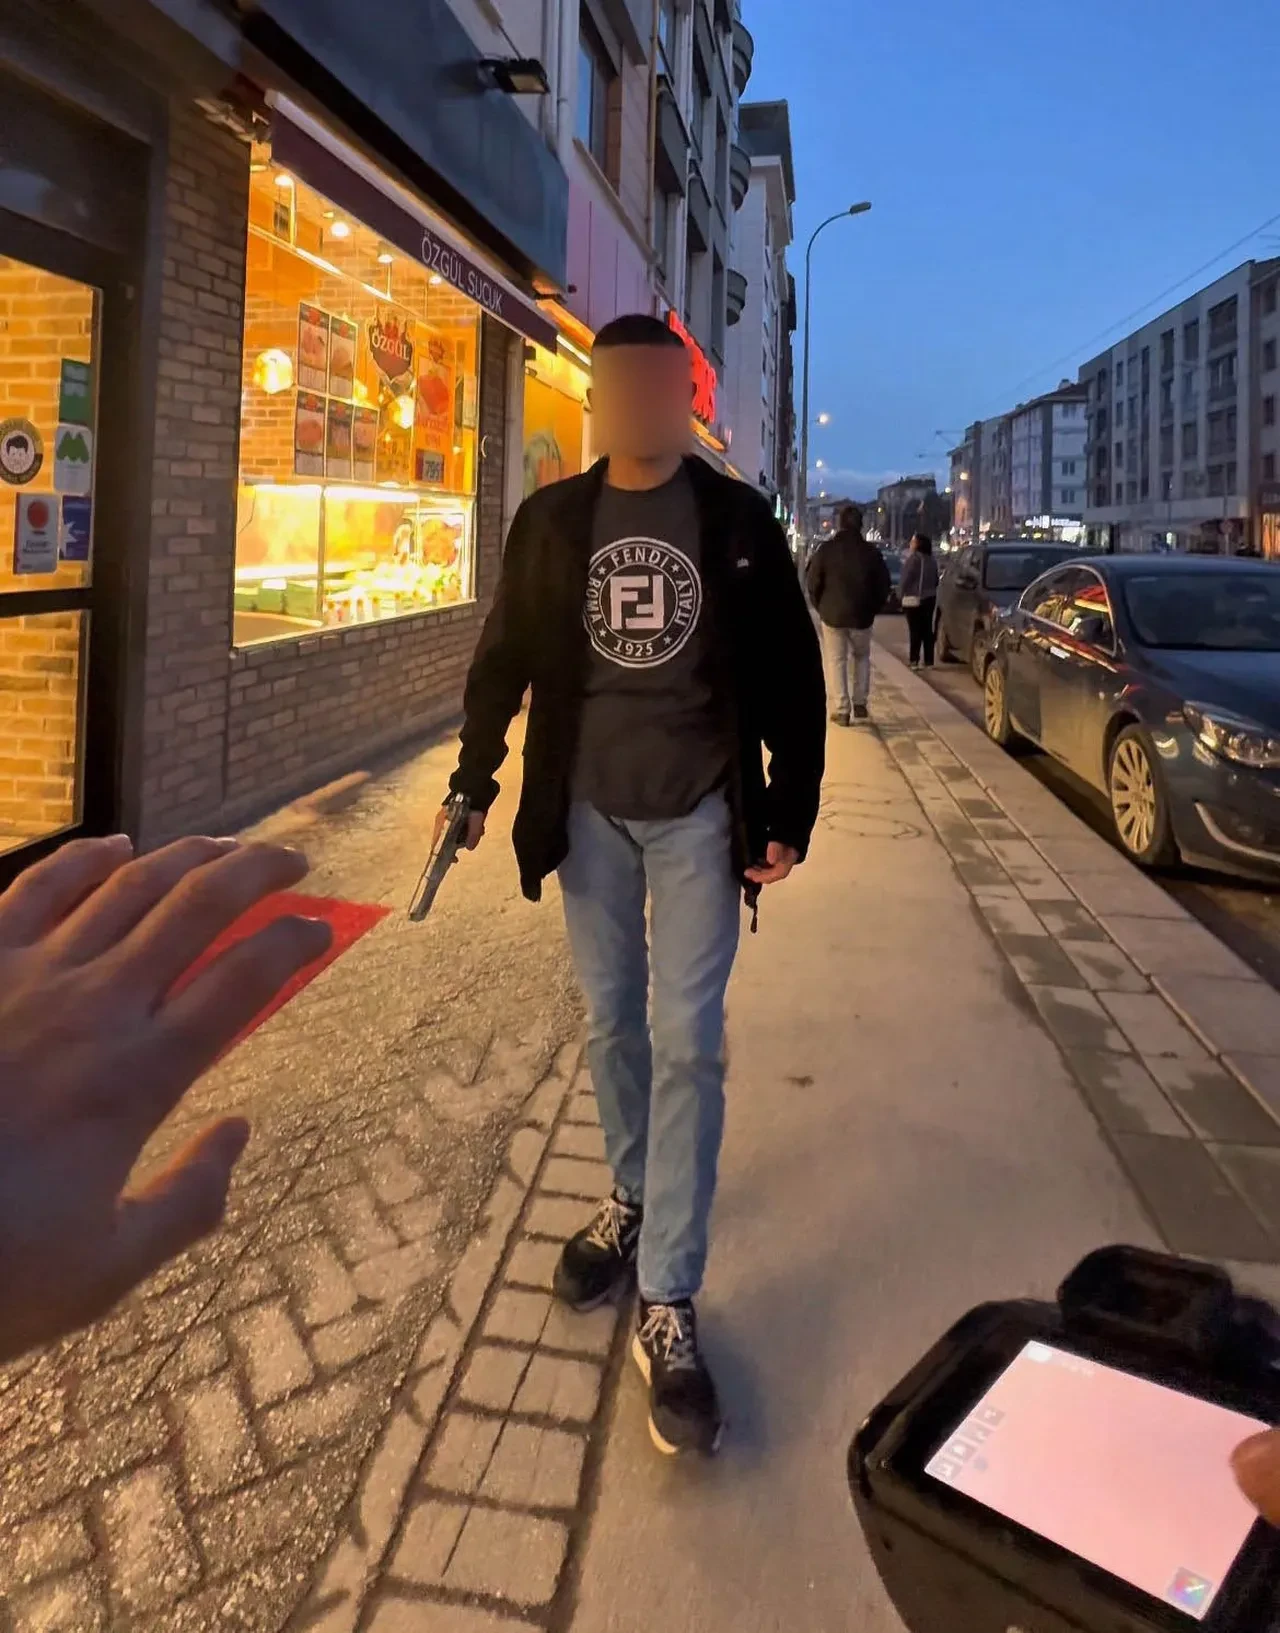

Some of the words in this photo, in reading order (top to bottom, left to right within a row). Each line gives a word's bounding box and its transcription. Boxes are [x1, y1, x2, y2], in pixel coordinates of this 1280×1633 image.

[421, 230, 466, 290] ÖZGÜL
[371, 327, 410, 361] ÖZGÜL
[610, 547, 670, 568] FENDI
[585, 576, 602, 622] ROMA
[674, 578, 694, 627] ITALY
[613, 640, 654, 657] 1925
